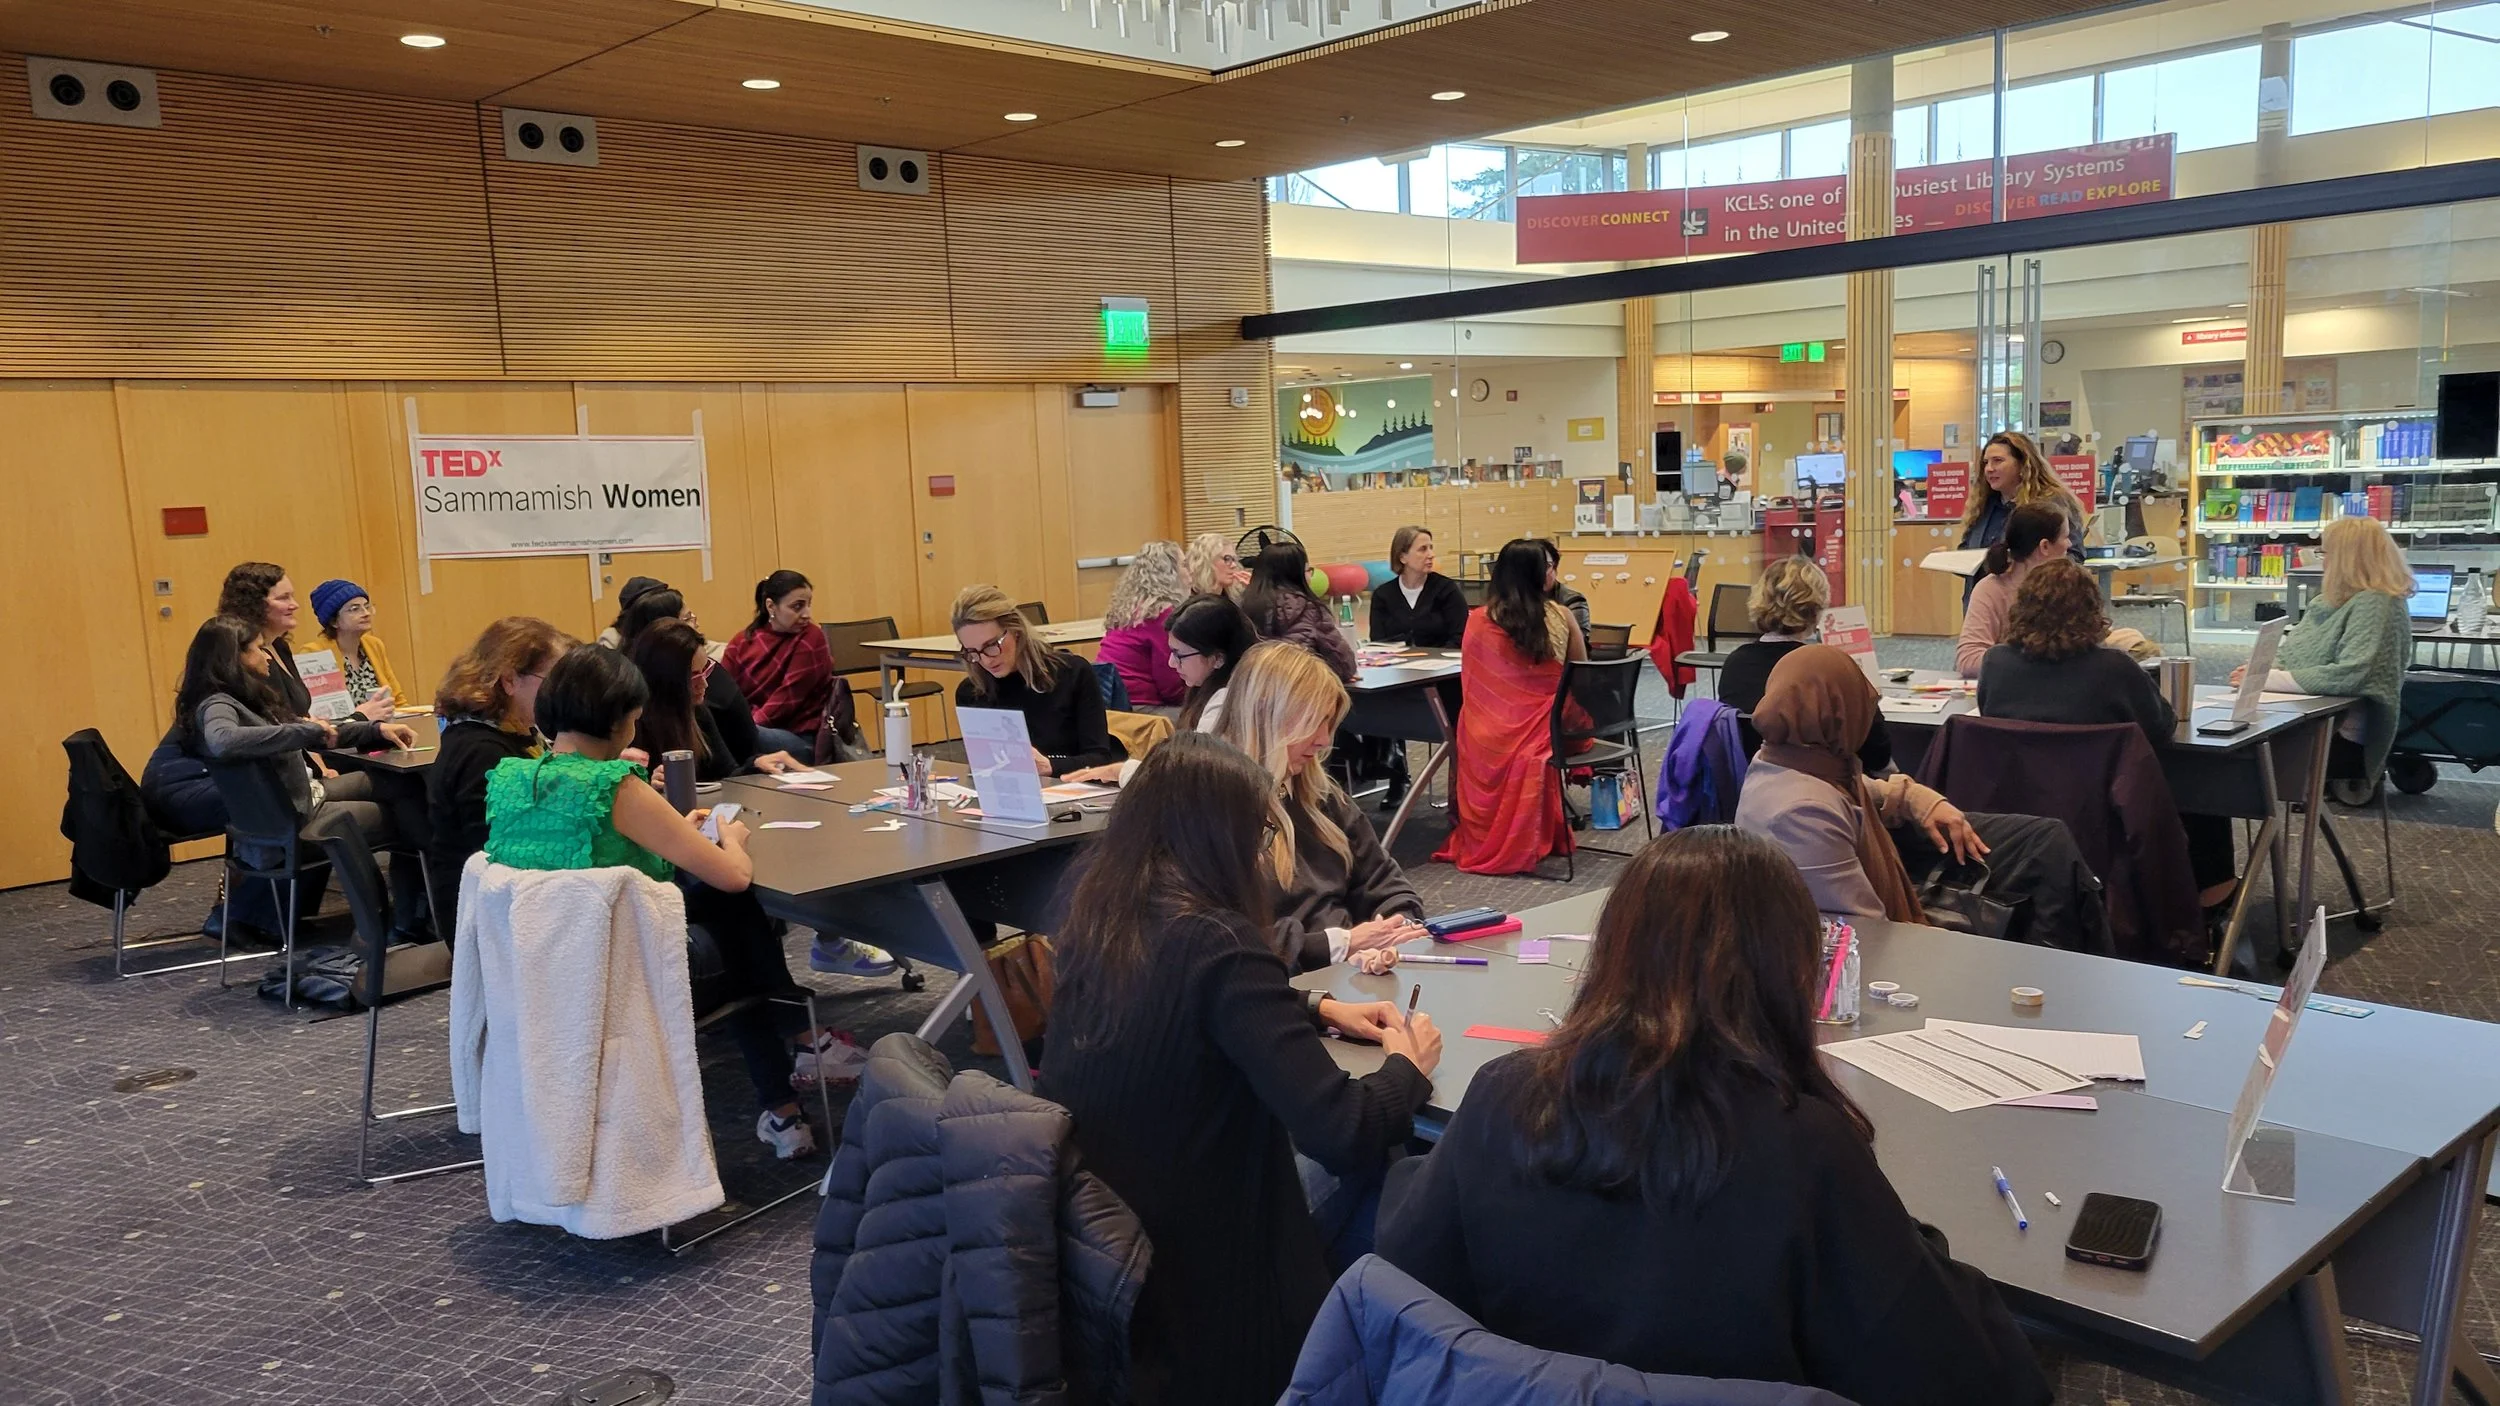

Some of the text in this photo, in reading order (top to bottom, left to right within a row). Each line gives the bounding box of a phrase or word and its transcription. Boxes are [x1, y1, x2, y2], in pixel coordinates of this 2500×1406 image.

[1725, 194, 1774, 213] KCLS:
[1780, 193, 1815, 209] one
[1822, 186, 1843, 205] of
[1966, 170, 2036, 191] Libary
[2043, 157, 2126, 185] Systems
[1955, 178, 2161, 217] DISCVER READ EXPLORE
[1601, 210, 1670, 226] CONNECT
[1725, 216, 1848, 242] in the United
[424, 483, 701, 513] Sammamish Women
